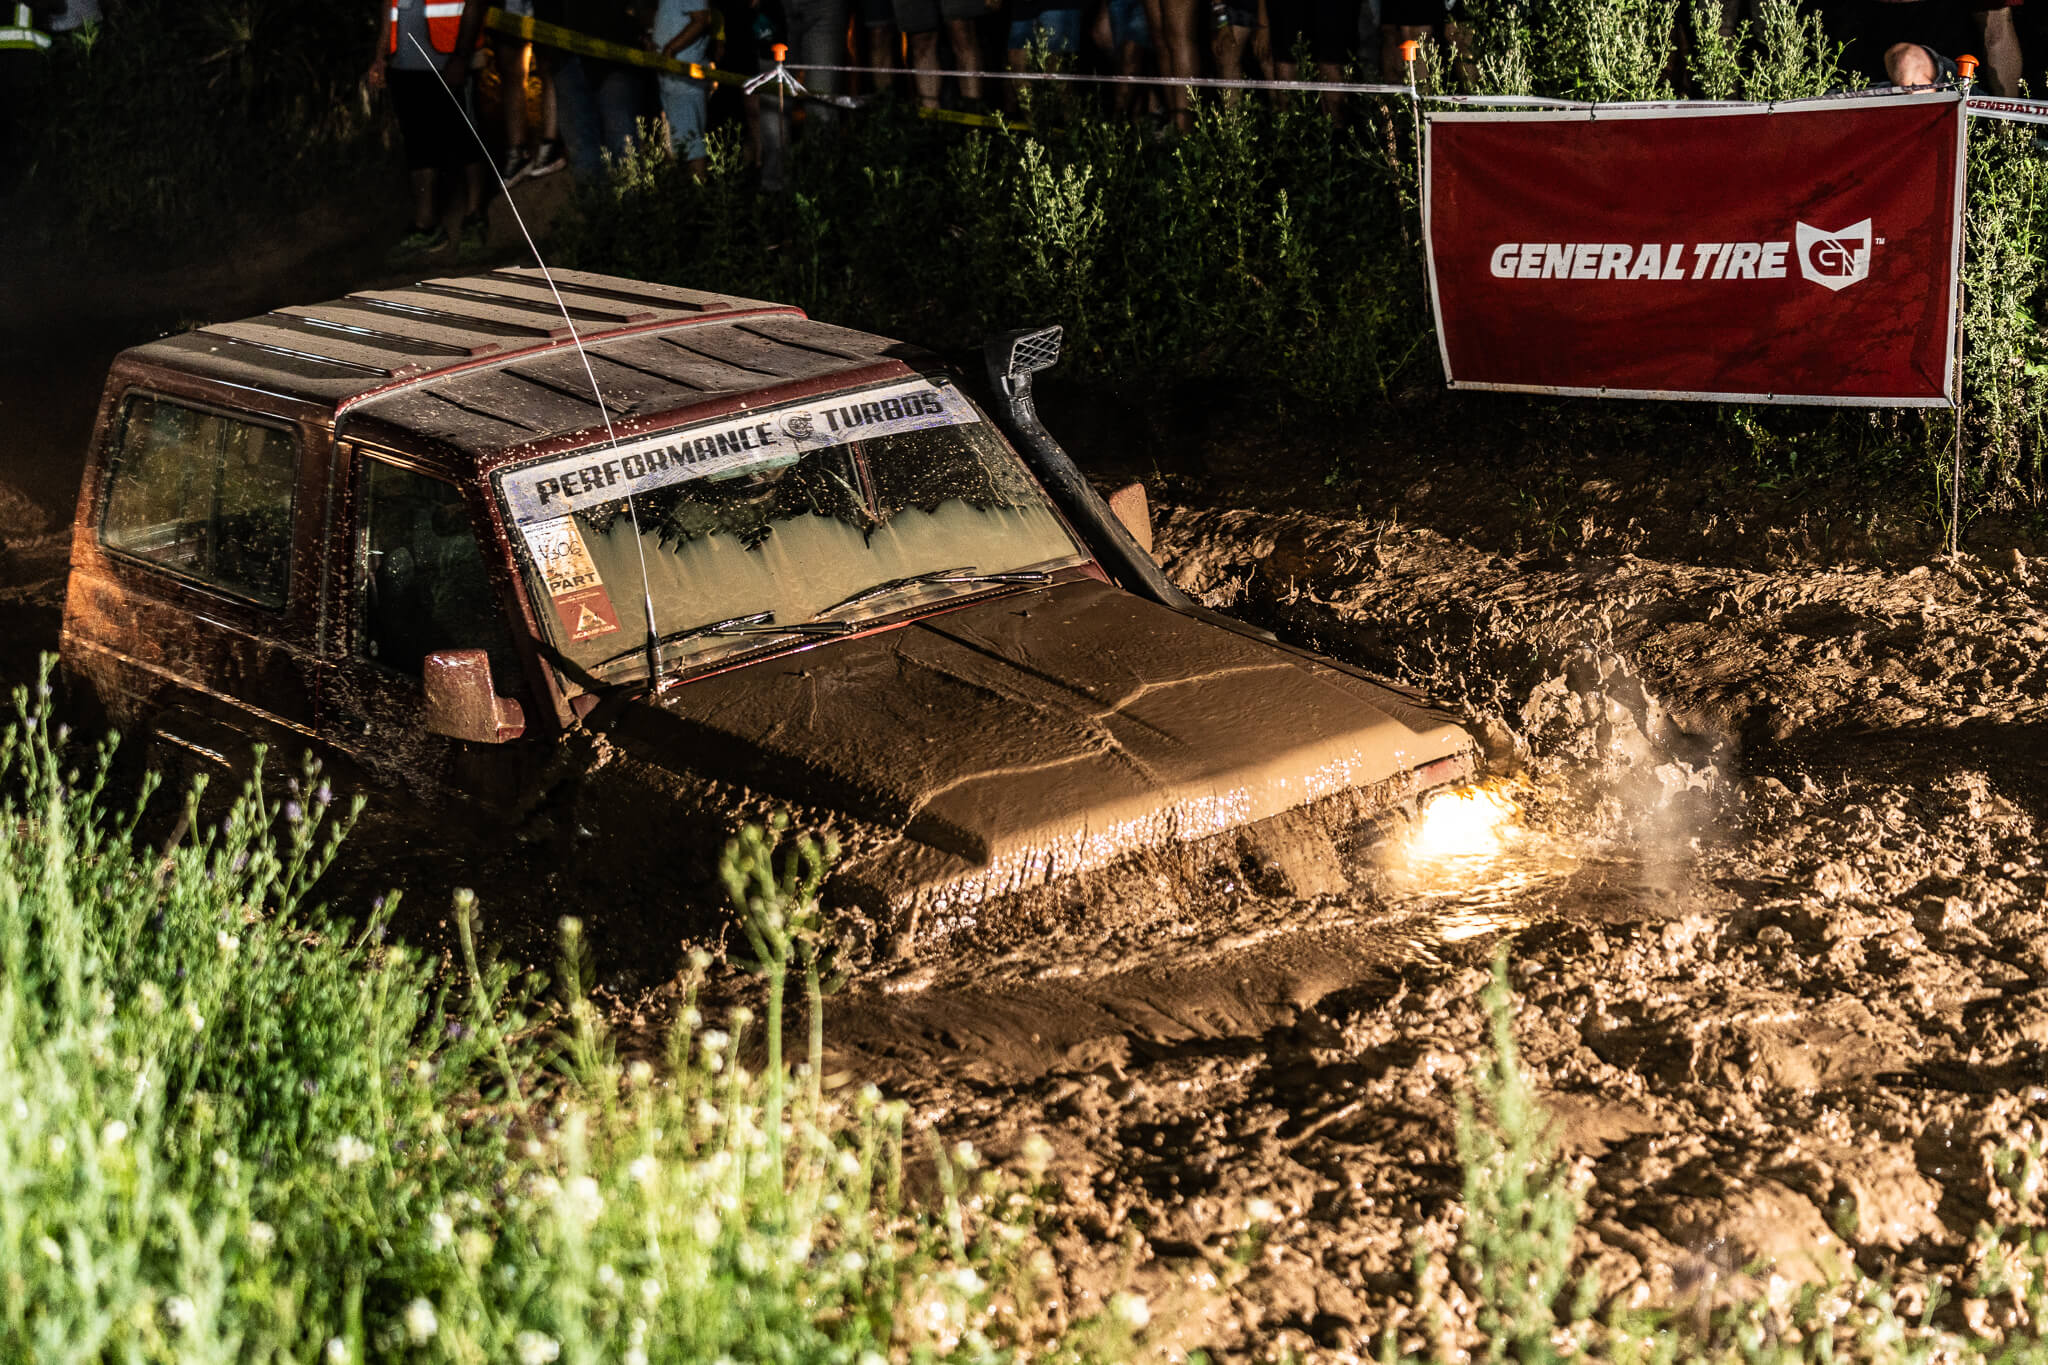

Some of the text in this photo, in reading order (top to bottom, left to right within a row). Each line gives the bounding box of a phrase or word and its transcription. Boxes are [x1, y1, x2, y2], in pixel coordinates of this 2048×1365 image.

[1966, 100, 2032, 114] GENERAL
[1490, 243, 1684, 280] GENERAL
[1691, 242, 1790, 280] TIRE
[535, 391, 944, 506] PERFORMANCE TURBOS
[549, 572, 596, 592] PART
